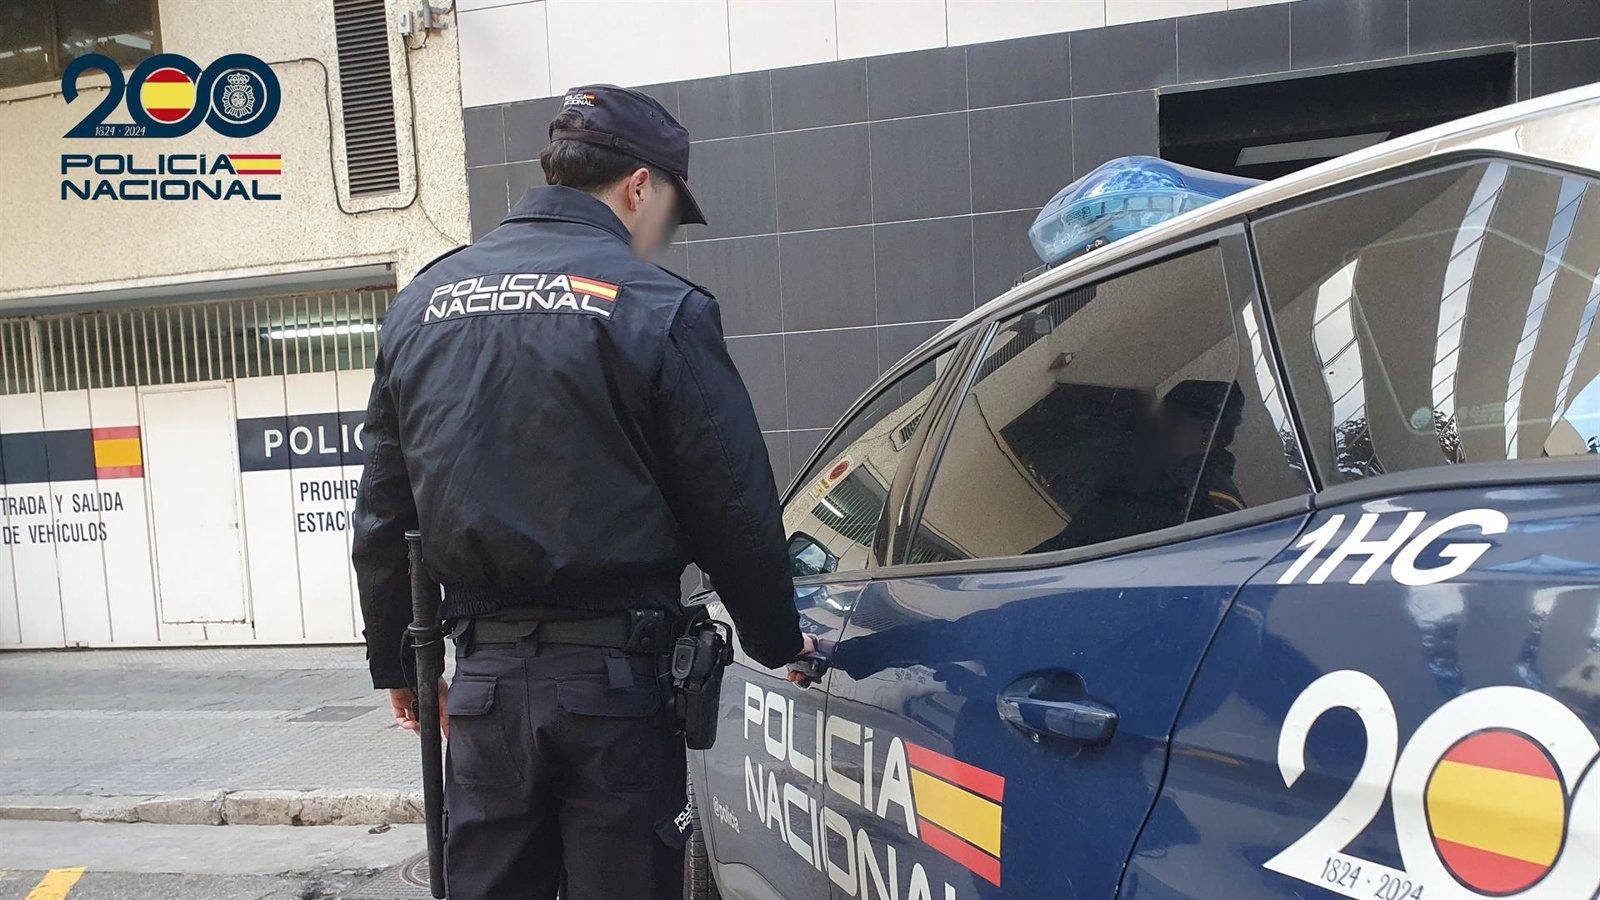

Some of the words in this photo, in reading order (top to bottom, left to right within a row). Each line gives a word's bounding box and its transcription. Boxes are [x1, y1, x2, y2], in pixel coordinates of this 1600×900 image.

[423, 291, 611, 323] NACIONAL
[54, 494, 63, 514] Y
[72, 491, 124, 513] SALIDA
[2, 526, 21, 545] DE
[28, 518, 108, 544] VEHÍCULOS
[1276, 508, 1509, 586] 1HG
[1262, 669, 1600, 900] 20
[744, 754, 957, 900] NACION
[1320, 856, 1362, 889] 1824
[1373, 873, 1425, 900] 2024
